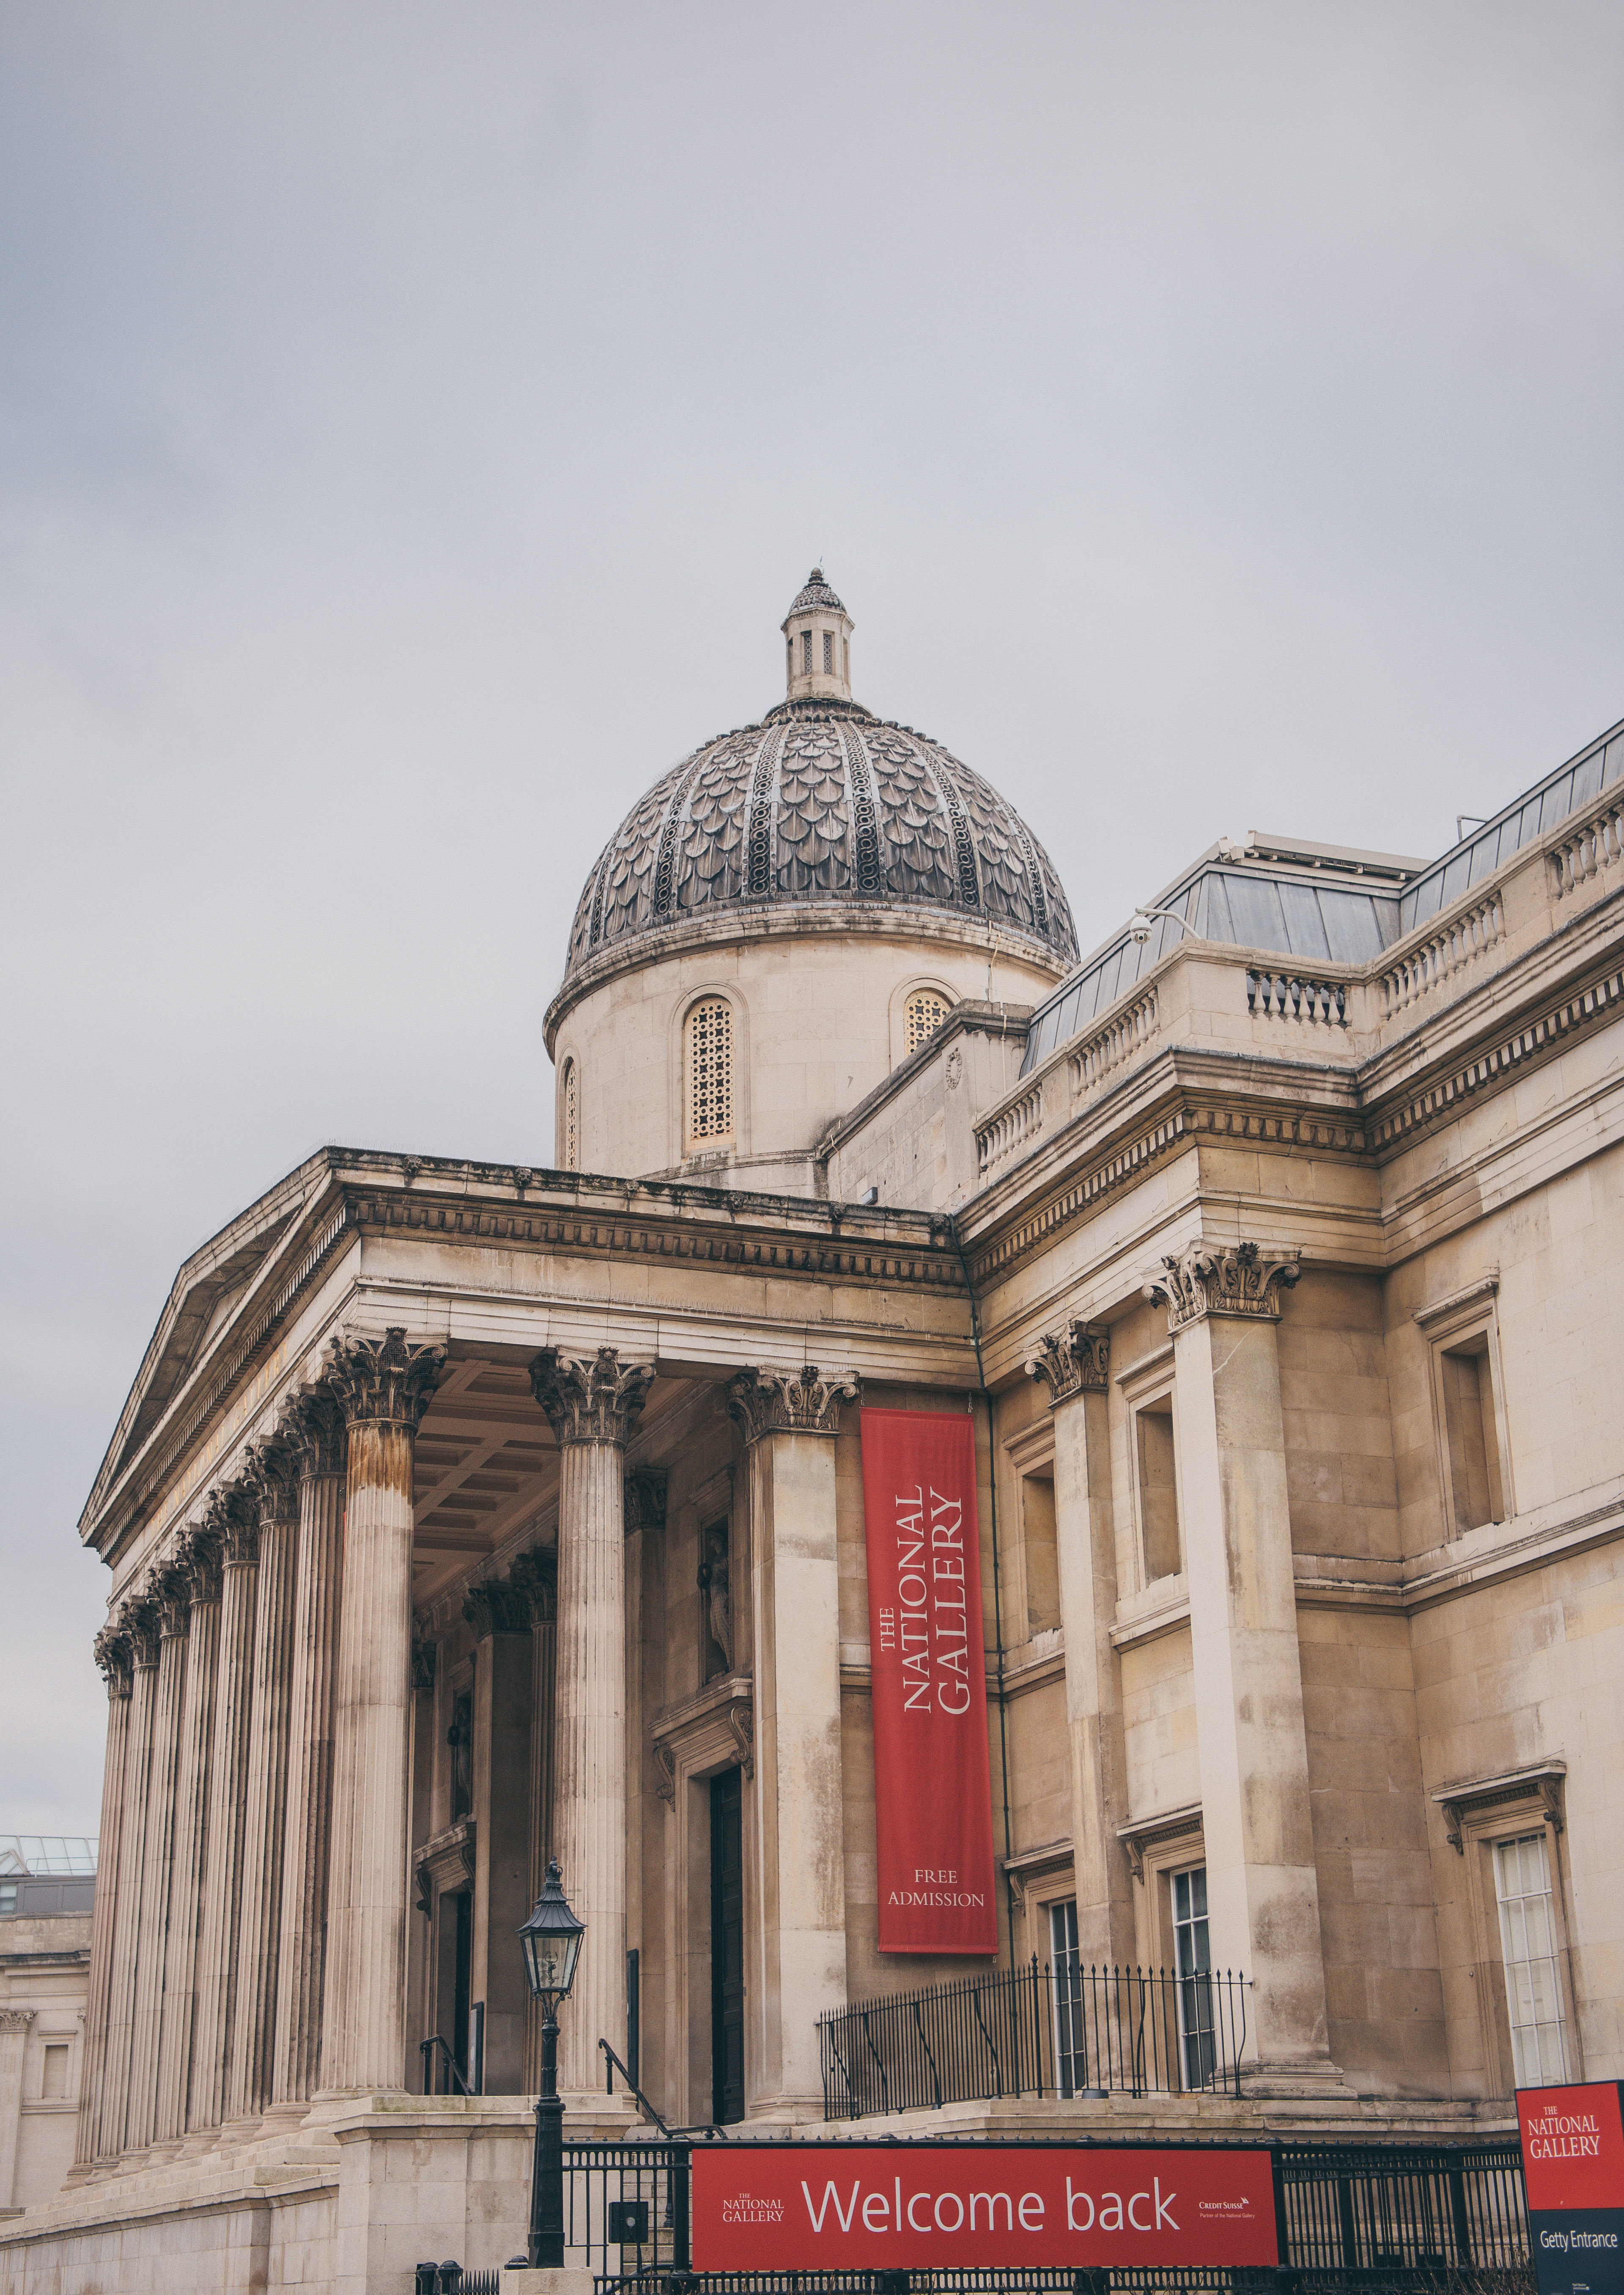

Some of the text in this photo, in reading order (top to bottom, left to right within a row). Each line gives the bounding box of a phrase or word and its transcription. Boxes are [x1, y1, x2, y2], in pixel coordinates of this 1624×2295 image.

[895, 1485, 932, 1713] NATIONAL
[930, 1486, 970, 1715] GALLERY
[880, 1608, 895, 1652] THE
[914, 1869, 957, 1883] FREE
[888, 1891, 984, 1907] ADMISSION
[1543, 2106, 1558, 2115] THE
[1527, 2115, 1599, 2136] NATIONAL
[1530, 2135, 1600, 2159] GALLERY
[723, 2199, 785, 2209] NATIONAL
[801, 2176, 1180, 2232] Welcome back
[722, 2210, 785, 2222] GALLERY
[1540, 2230, 1618, 2252] Getty Entrance
